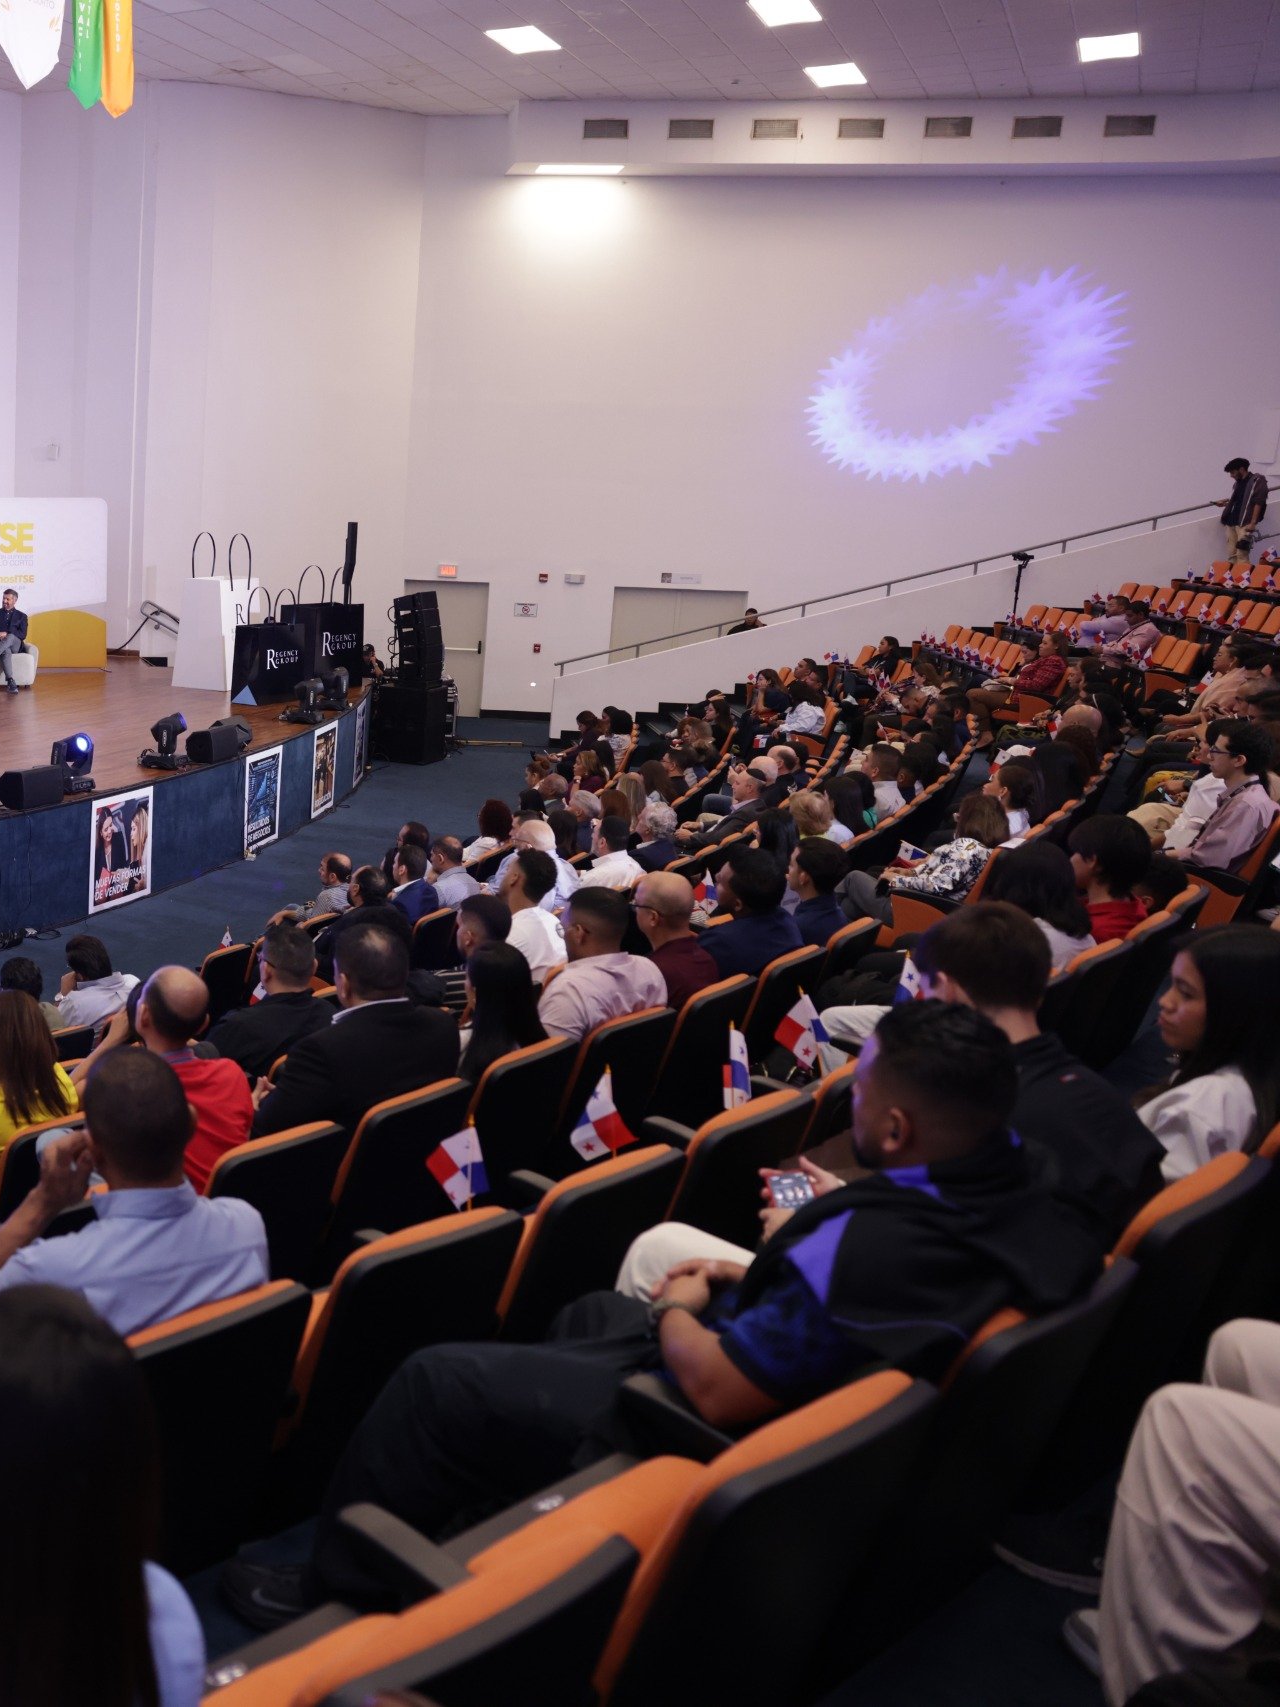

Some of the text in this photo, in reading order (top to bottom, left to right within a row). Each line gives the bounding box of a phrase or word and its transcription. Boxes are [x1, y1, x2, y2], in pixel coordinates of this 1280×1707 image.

[322, 632, 356, 656] REGENCY
[331, 641, 356, 650] GROUP
[267, 649, 298, 670] REGENCY
[275, 656, 299, 665] GROUP
[95, 865, 146, 889] NUEVAS FORMAS
[95, 882, 128, 900] DE VENDER
